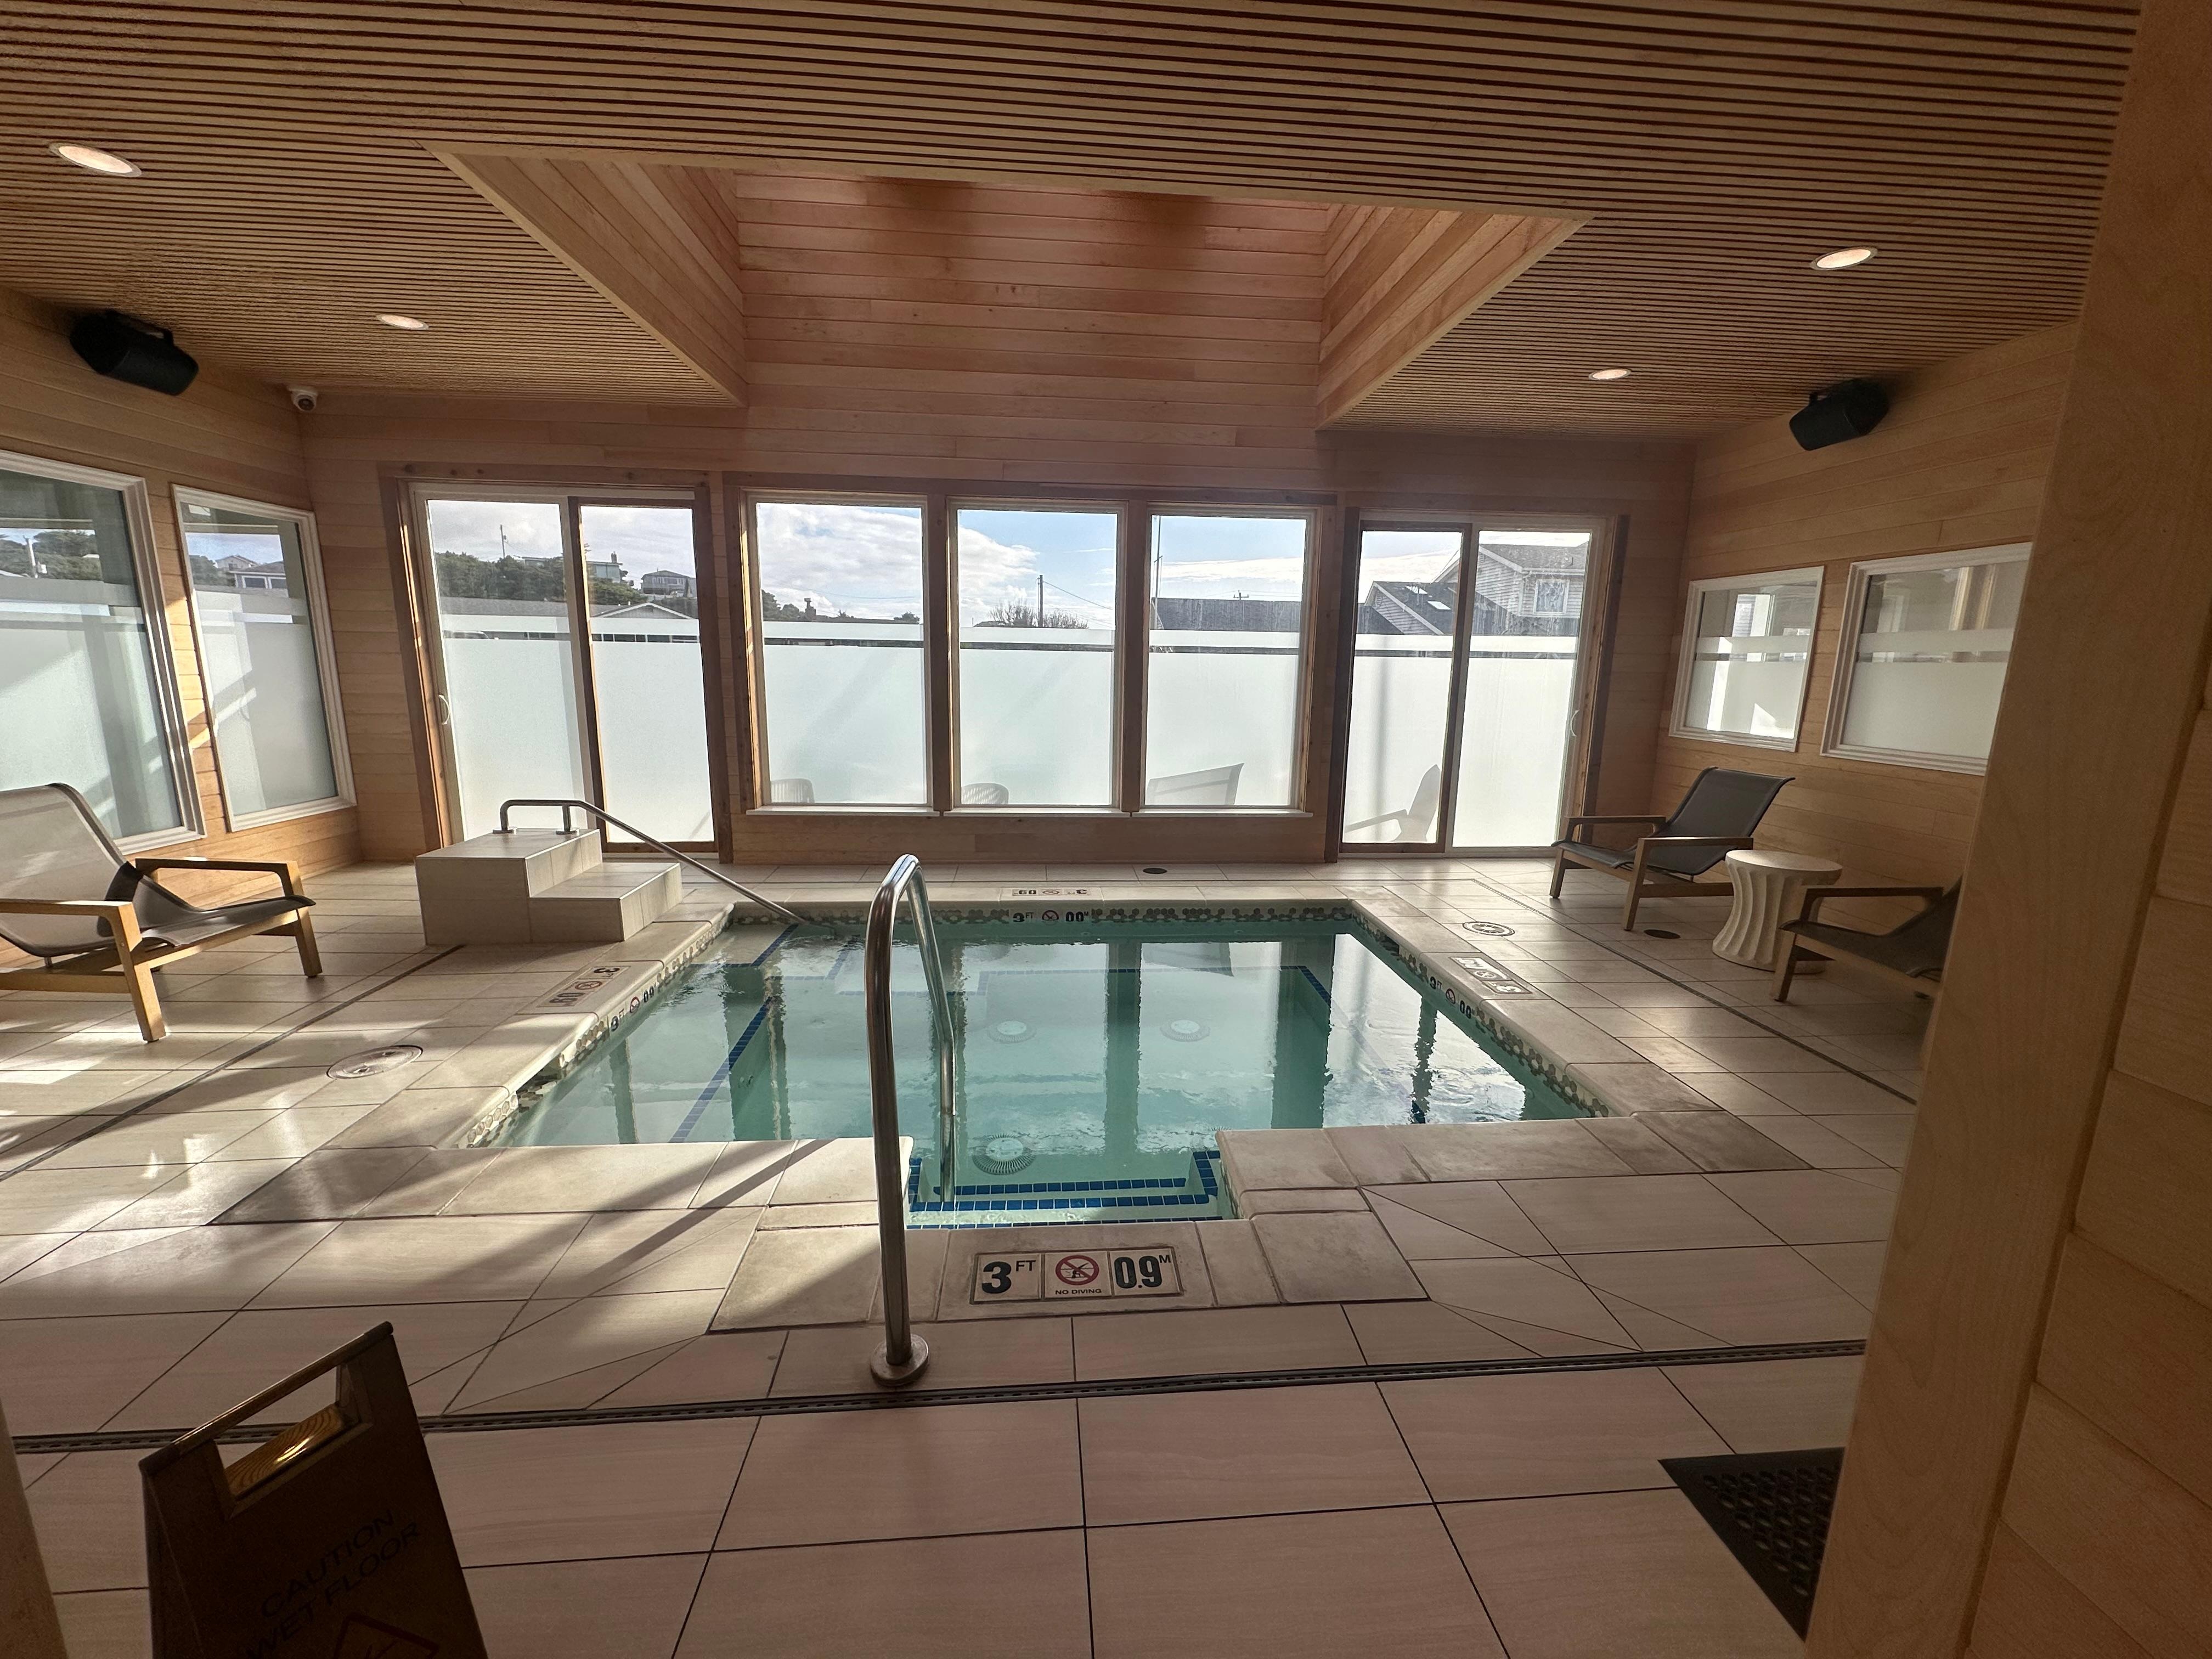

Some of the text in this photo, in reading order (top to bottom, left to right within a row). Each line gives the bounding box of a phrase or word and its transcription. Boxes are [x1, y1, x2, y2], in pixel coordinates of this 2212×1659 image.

[1013, 912, 1025, 922] 3
[981, 1260, 1036, 1294] 3 FT
[1114, 1255, 1171, 1289] 0.9 M
[261, 1508, 395, 1618] CAUTION
[245, 1522, 419, 1659] WET FLOOR
